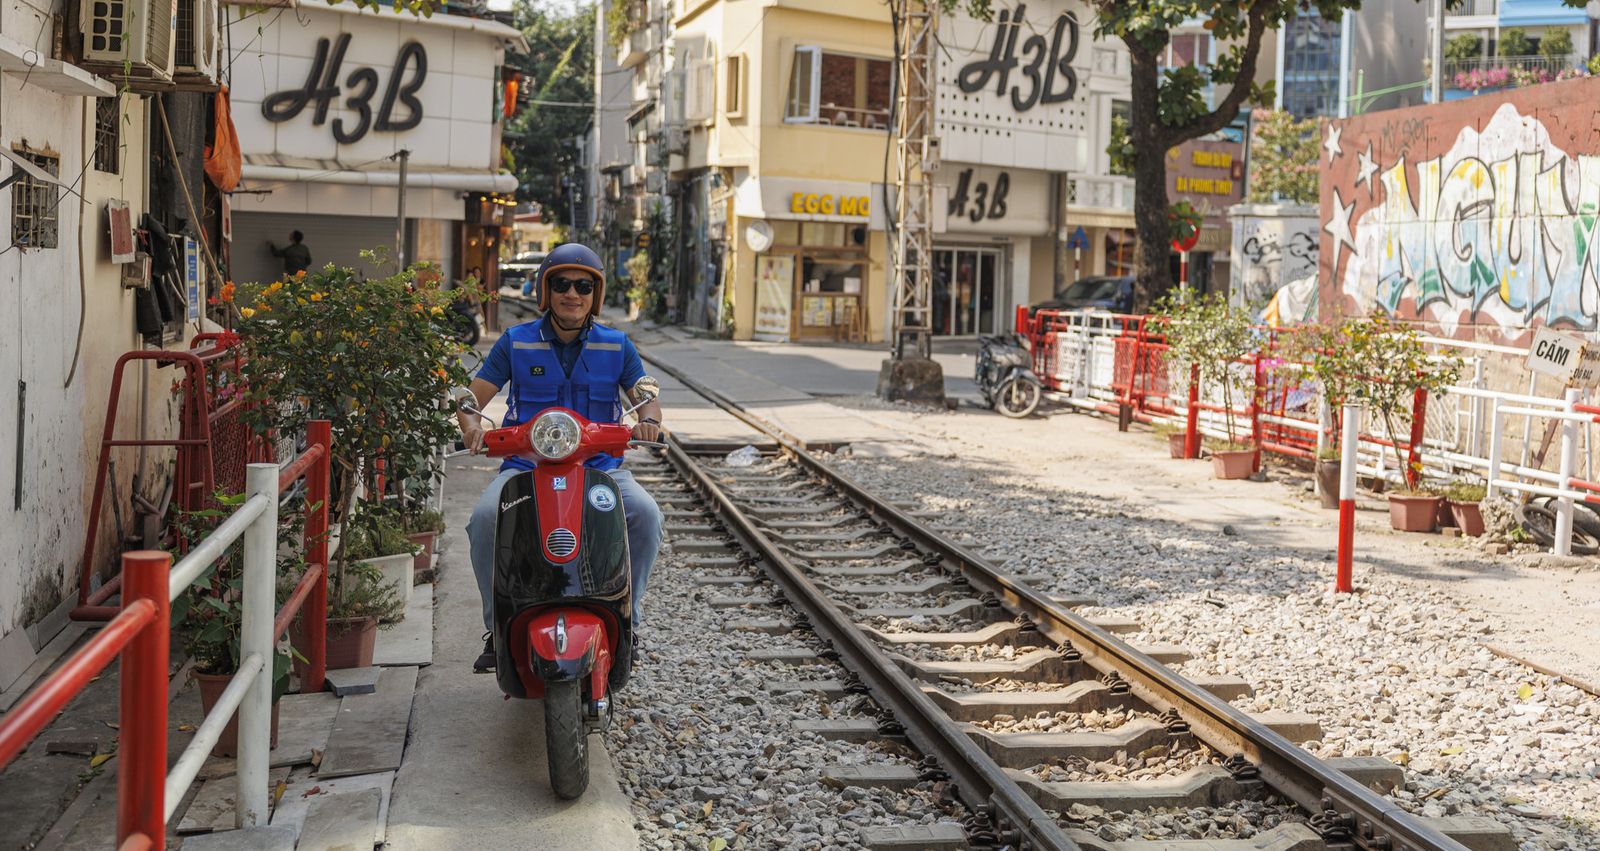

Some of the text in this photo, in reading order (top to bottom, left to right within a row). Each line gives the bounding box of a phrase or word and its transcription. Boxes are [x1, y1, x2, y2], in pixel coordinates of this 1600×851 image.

[958, 3, 1079, 112] H3B
[261, 32, 428, 145] H3B
[791, 191, 834, 214] EGG
[947, 168, 1010, 223] H3B
[1536, 338, 1570, 366] CẤM
